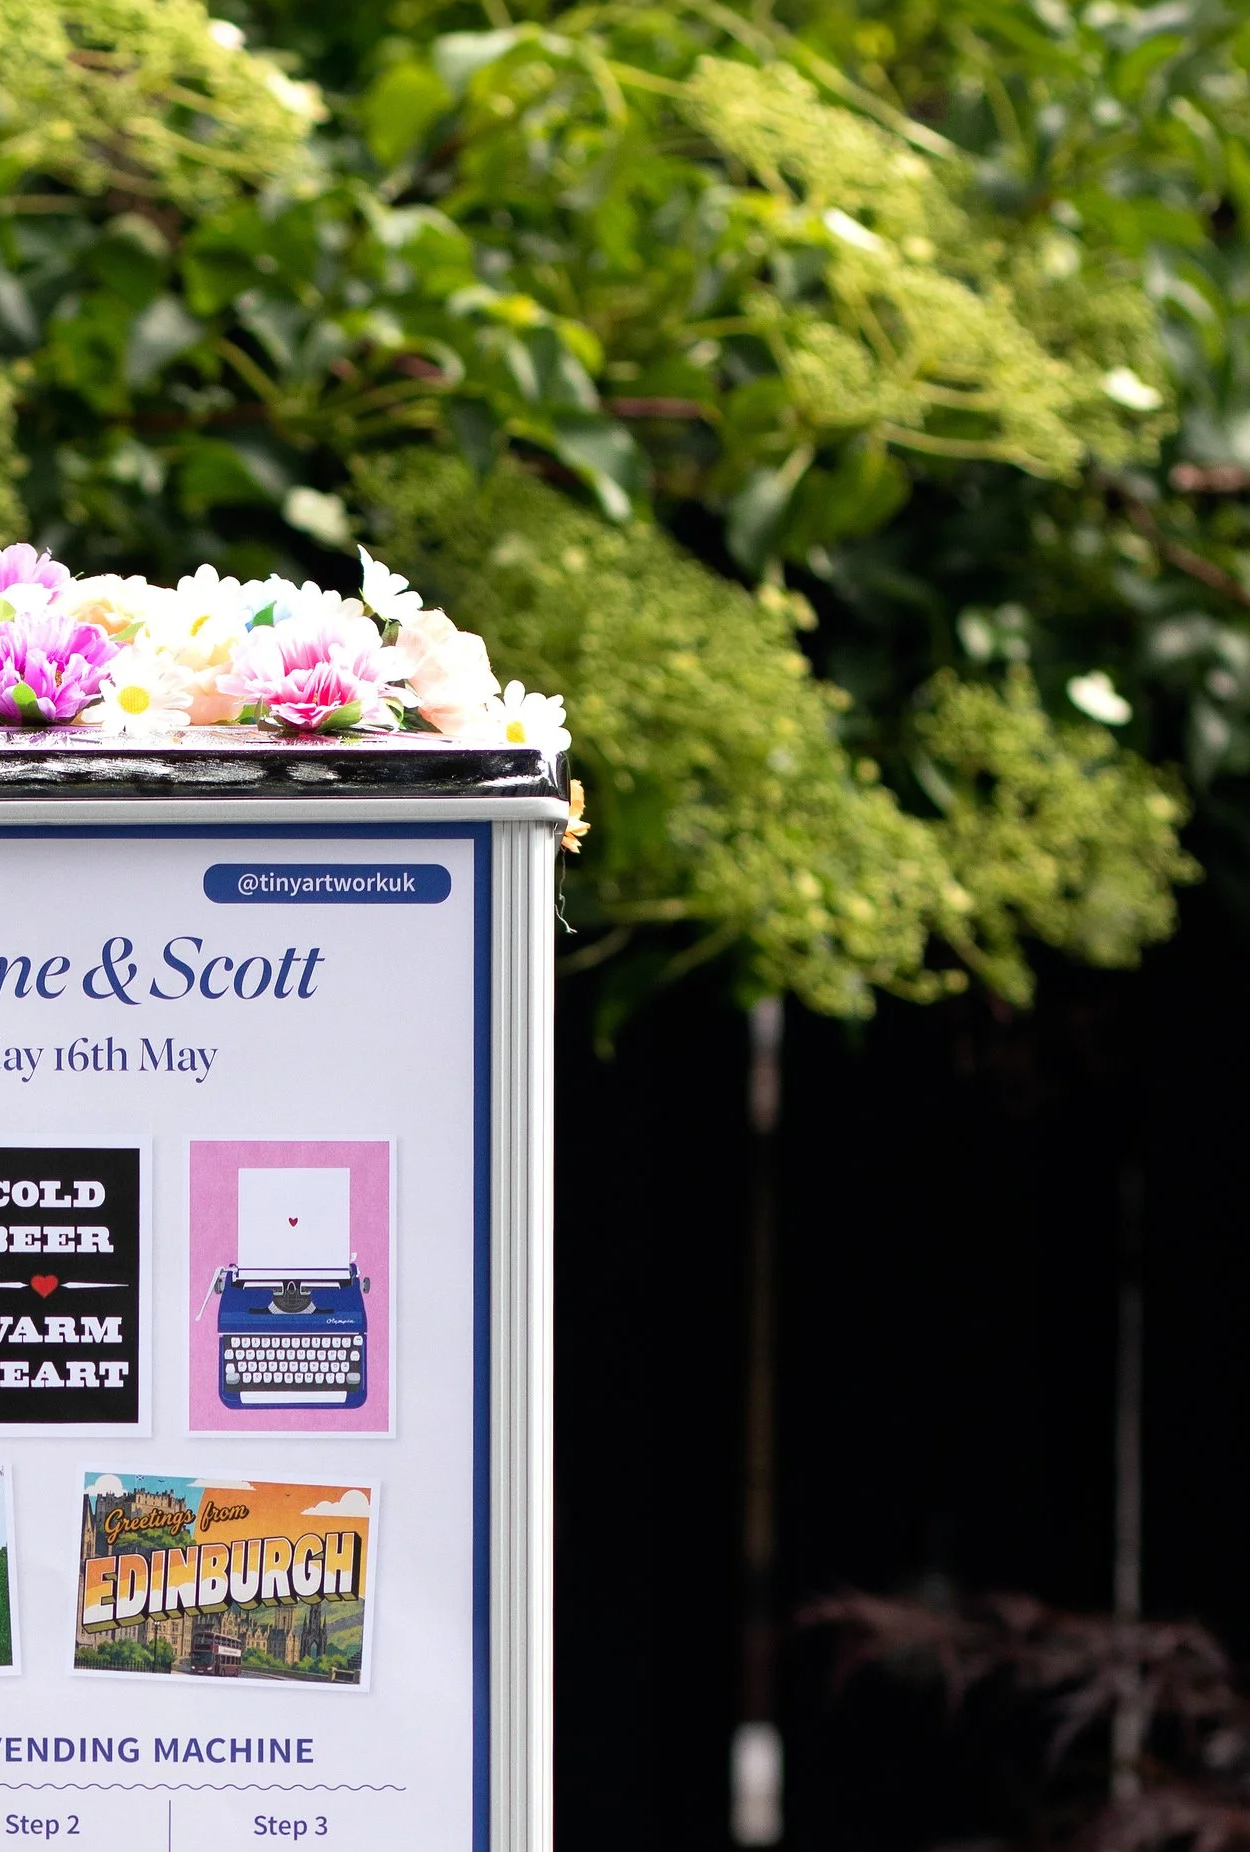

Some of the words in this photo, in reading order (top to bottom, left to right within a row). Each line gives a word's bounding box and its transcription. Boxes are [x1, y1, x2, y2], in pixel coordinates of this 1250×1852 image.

[237, 872, 416, 897] @tinyartworkuk
[82, 936, 142, 1006] &
[149, 936, 326, 1000] Scott
[53, 1036, 128, 1072] 16th
[138, 1037, 219, 1084] May
[104, 1505, 194, 1541] Greetings
[199, 1502, 249, 1531] from
[81, 1531, 361, 1634] EDINBURGH
[154, 1737, 314, 1764] MACHINE
[5, 1814, 60, 1840] Step
[66, 1814, 80, 1835] 2
[253, 1815, 308, 1841] Step
[314, 1815, 328, 1836] 3
